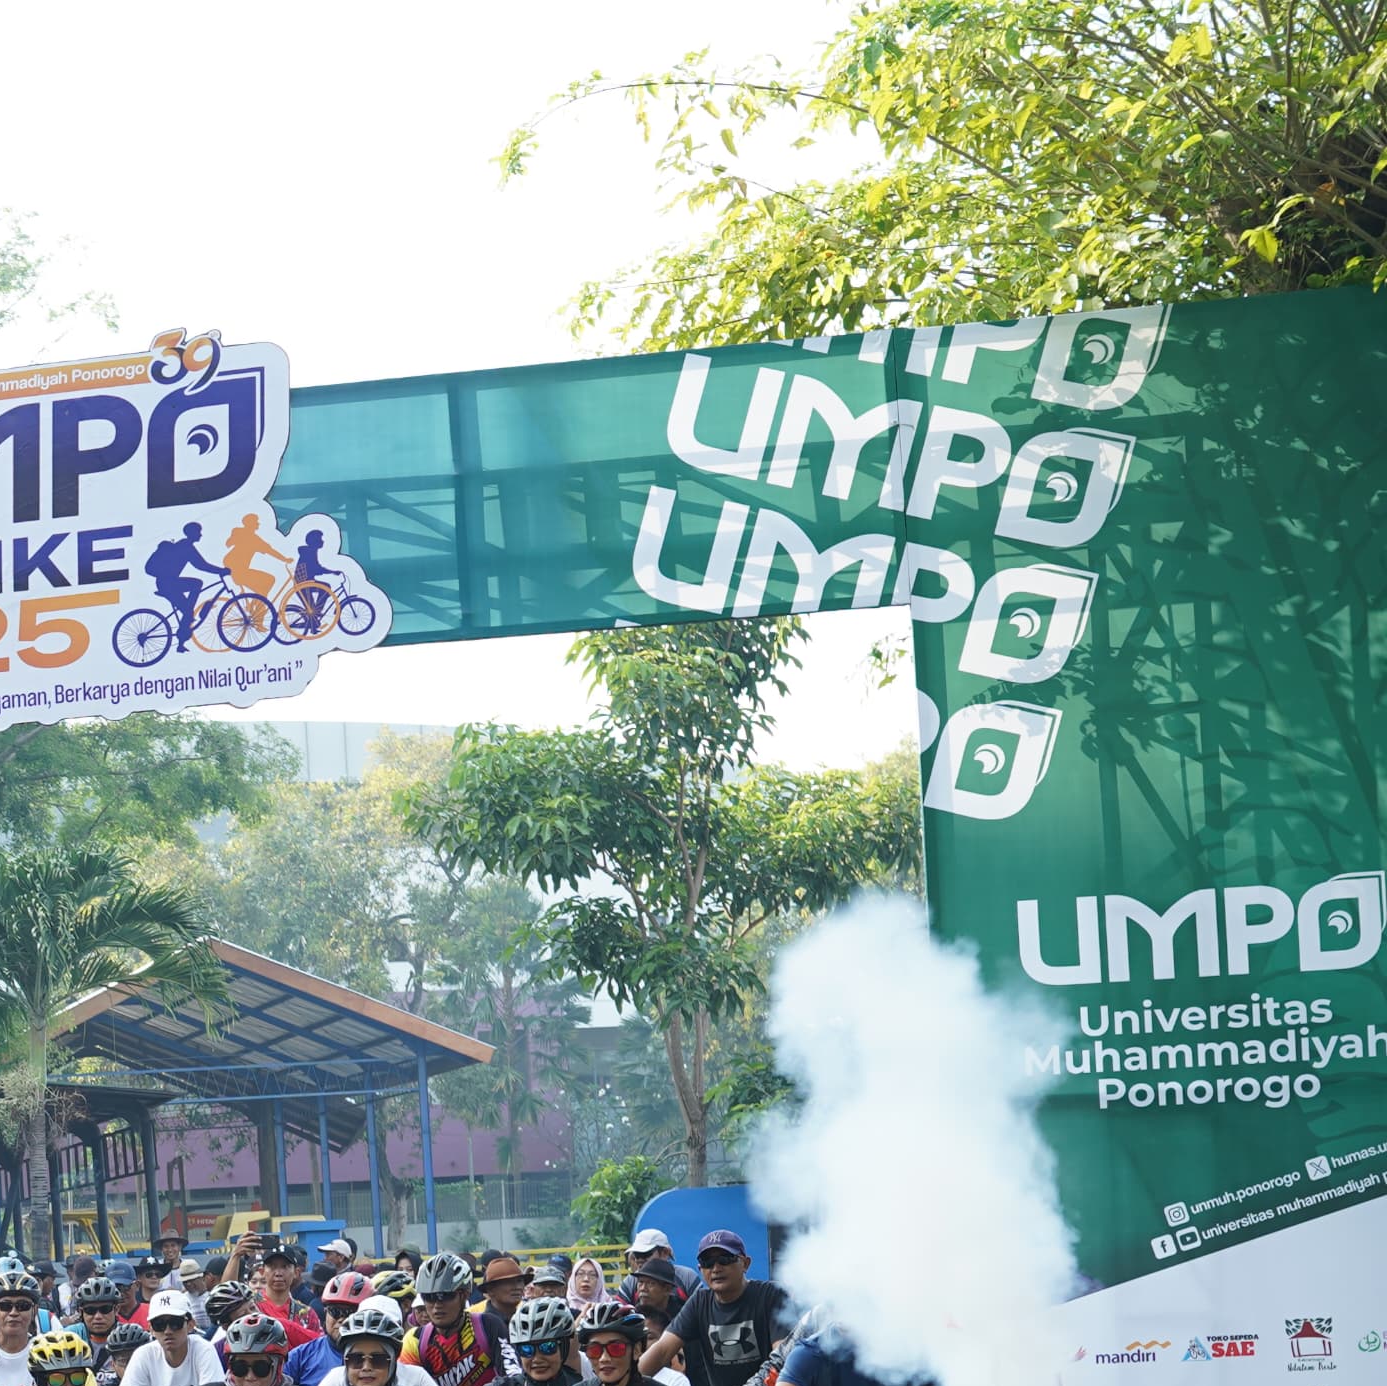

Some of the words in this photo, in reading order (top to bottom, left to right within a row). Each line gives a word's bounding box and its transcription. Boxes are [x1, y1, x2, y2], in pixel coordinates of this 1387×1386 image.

[71, 361, 145, 383] Ponorogo
[666, 352, 1136, 548] UMPO
[55, 681, 130, 704] Berkarya
[134, 675, 196, 699] dengan
[198, 667, 233, 690] Nilai
[1017, 870, 1387, 986] UMPO
[1079, 992, 1333, 1037] Universitas
[1025, 1025, 1387, 1078] Muhammadiyah
[1098, 1072, 1322, 1110] Ponorogo
[1190, 1170, 1301, 1215] unmuh.ponorogo
[1201, 1208, 1275, 1241] universitas
[1276, 1173, 1380, 1217] muhammadiyah
[1095, 1349, 1156, 1364] mandiri
[1211, 1341, 1255, 1358] SAE
